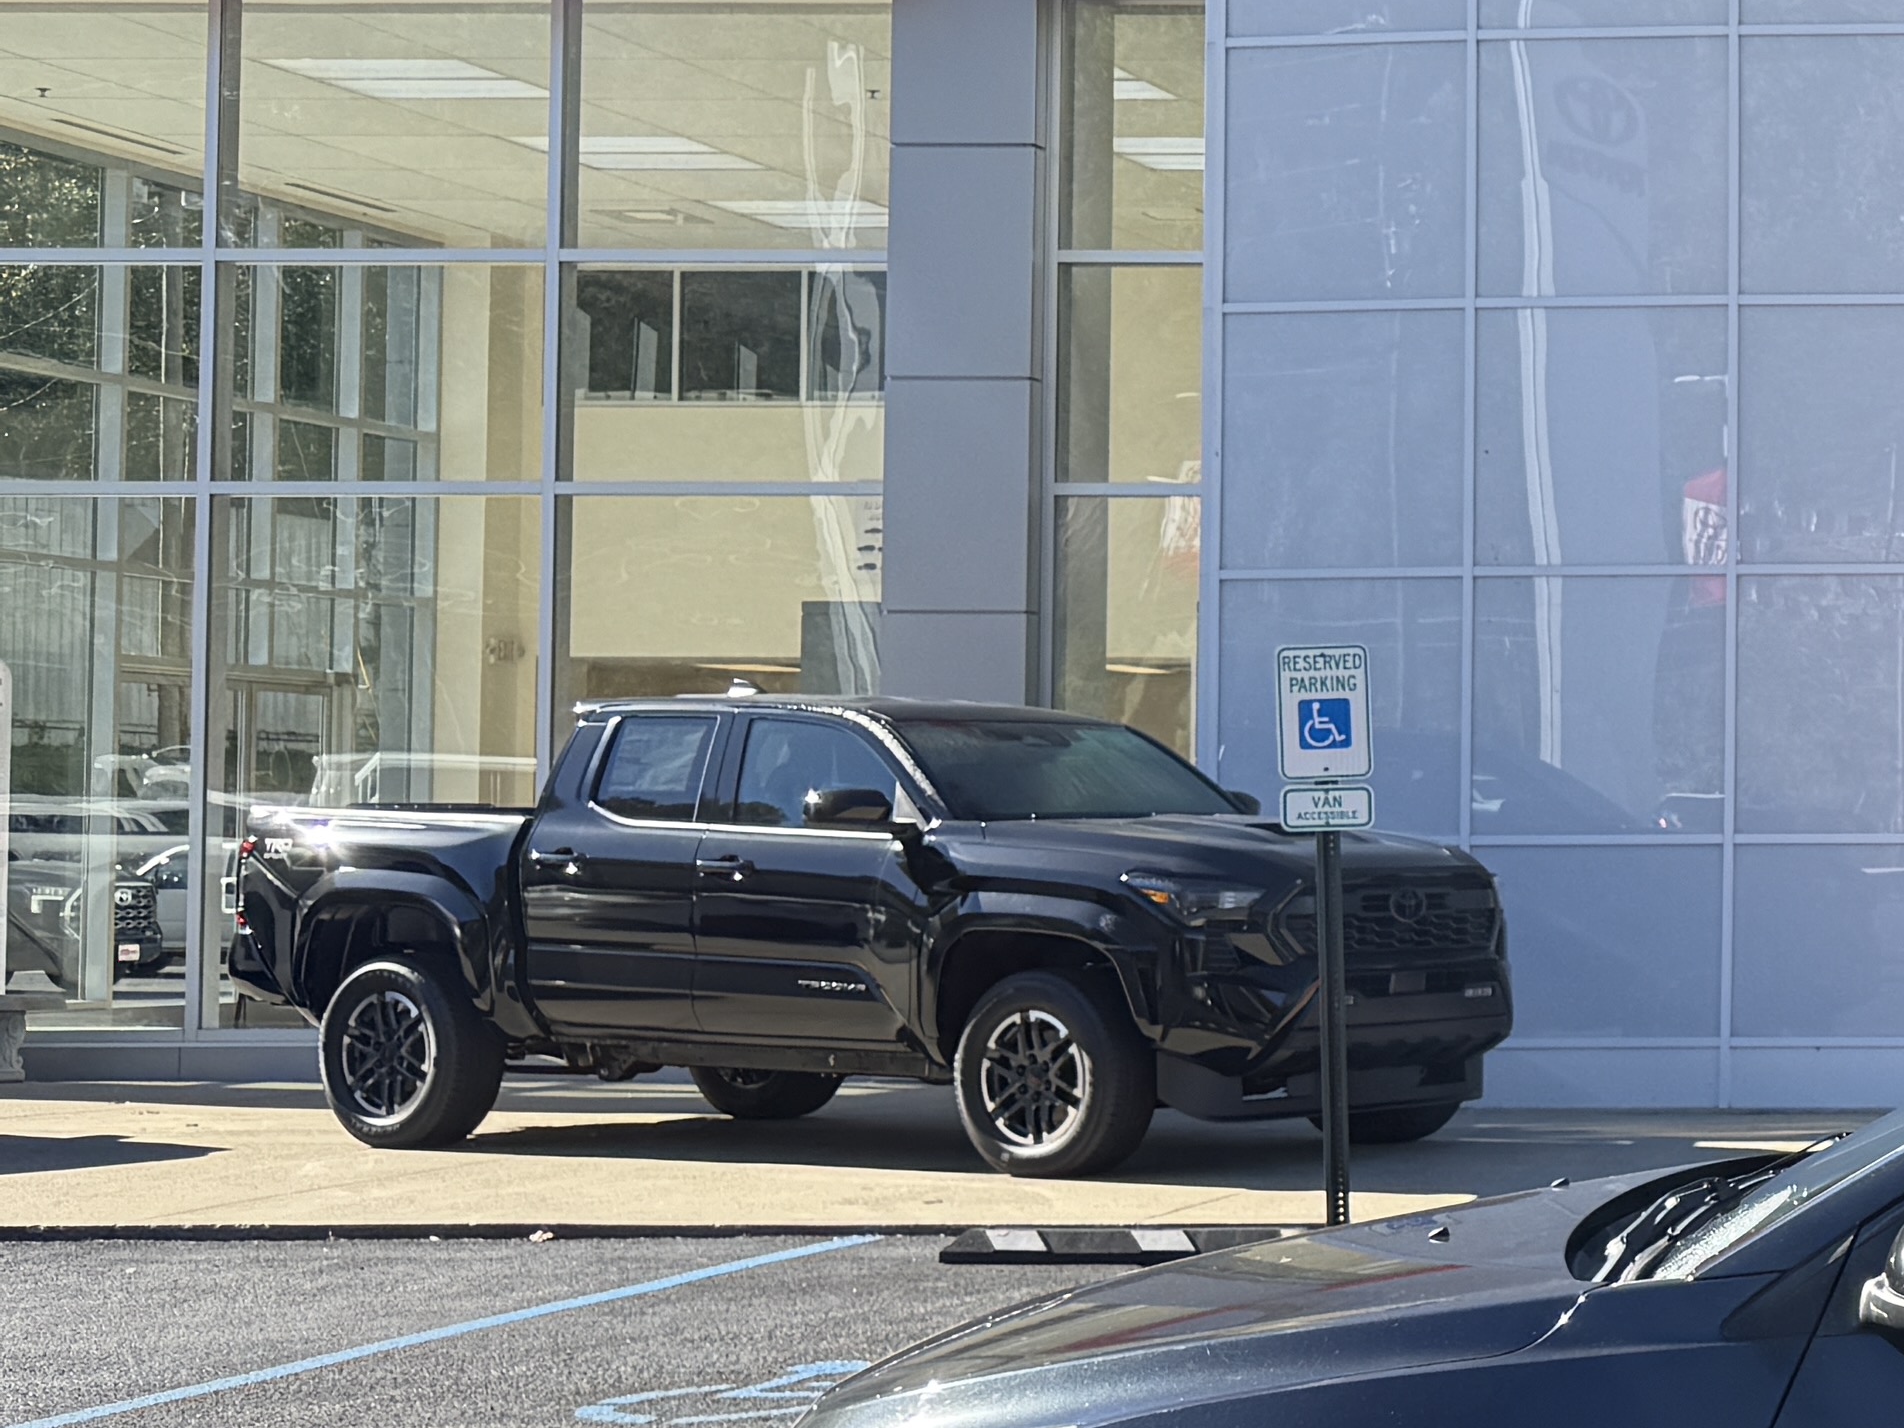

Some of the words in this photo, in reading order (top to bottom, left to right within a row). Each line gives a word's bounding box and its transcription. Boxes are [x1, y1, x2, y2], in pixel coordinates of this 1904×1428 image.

[1282, 653, 1362, 672] RESERVED
[1289, 675, 1357, 693] PARKING
[1312, 795, 1343, 808] VAN
[1297, 810, 1359, 821] ACCESSIBLE
